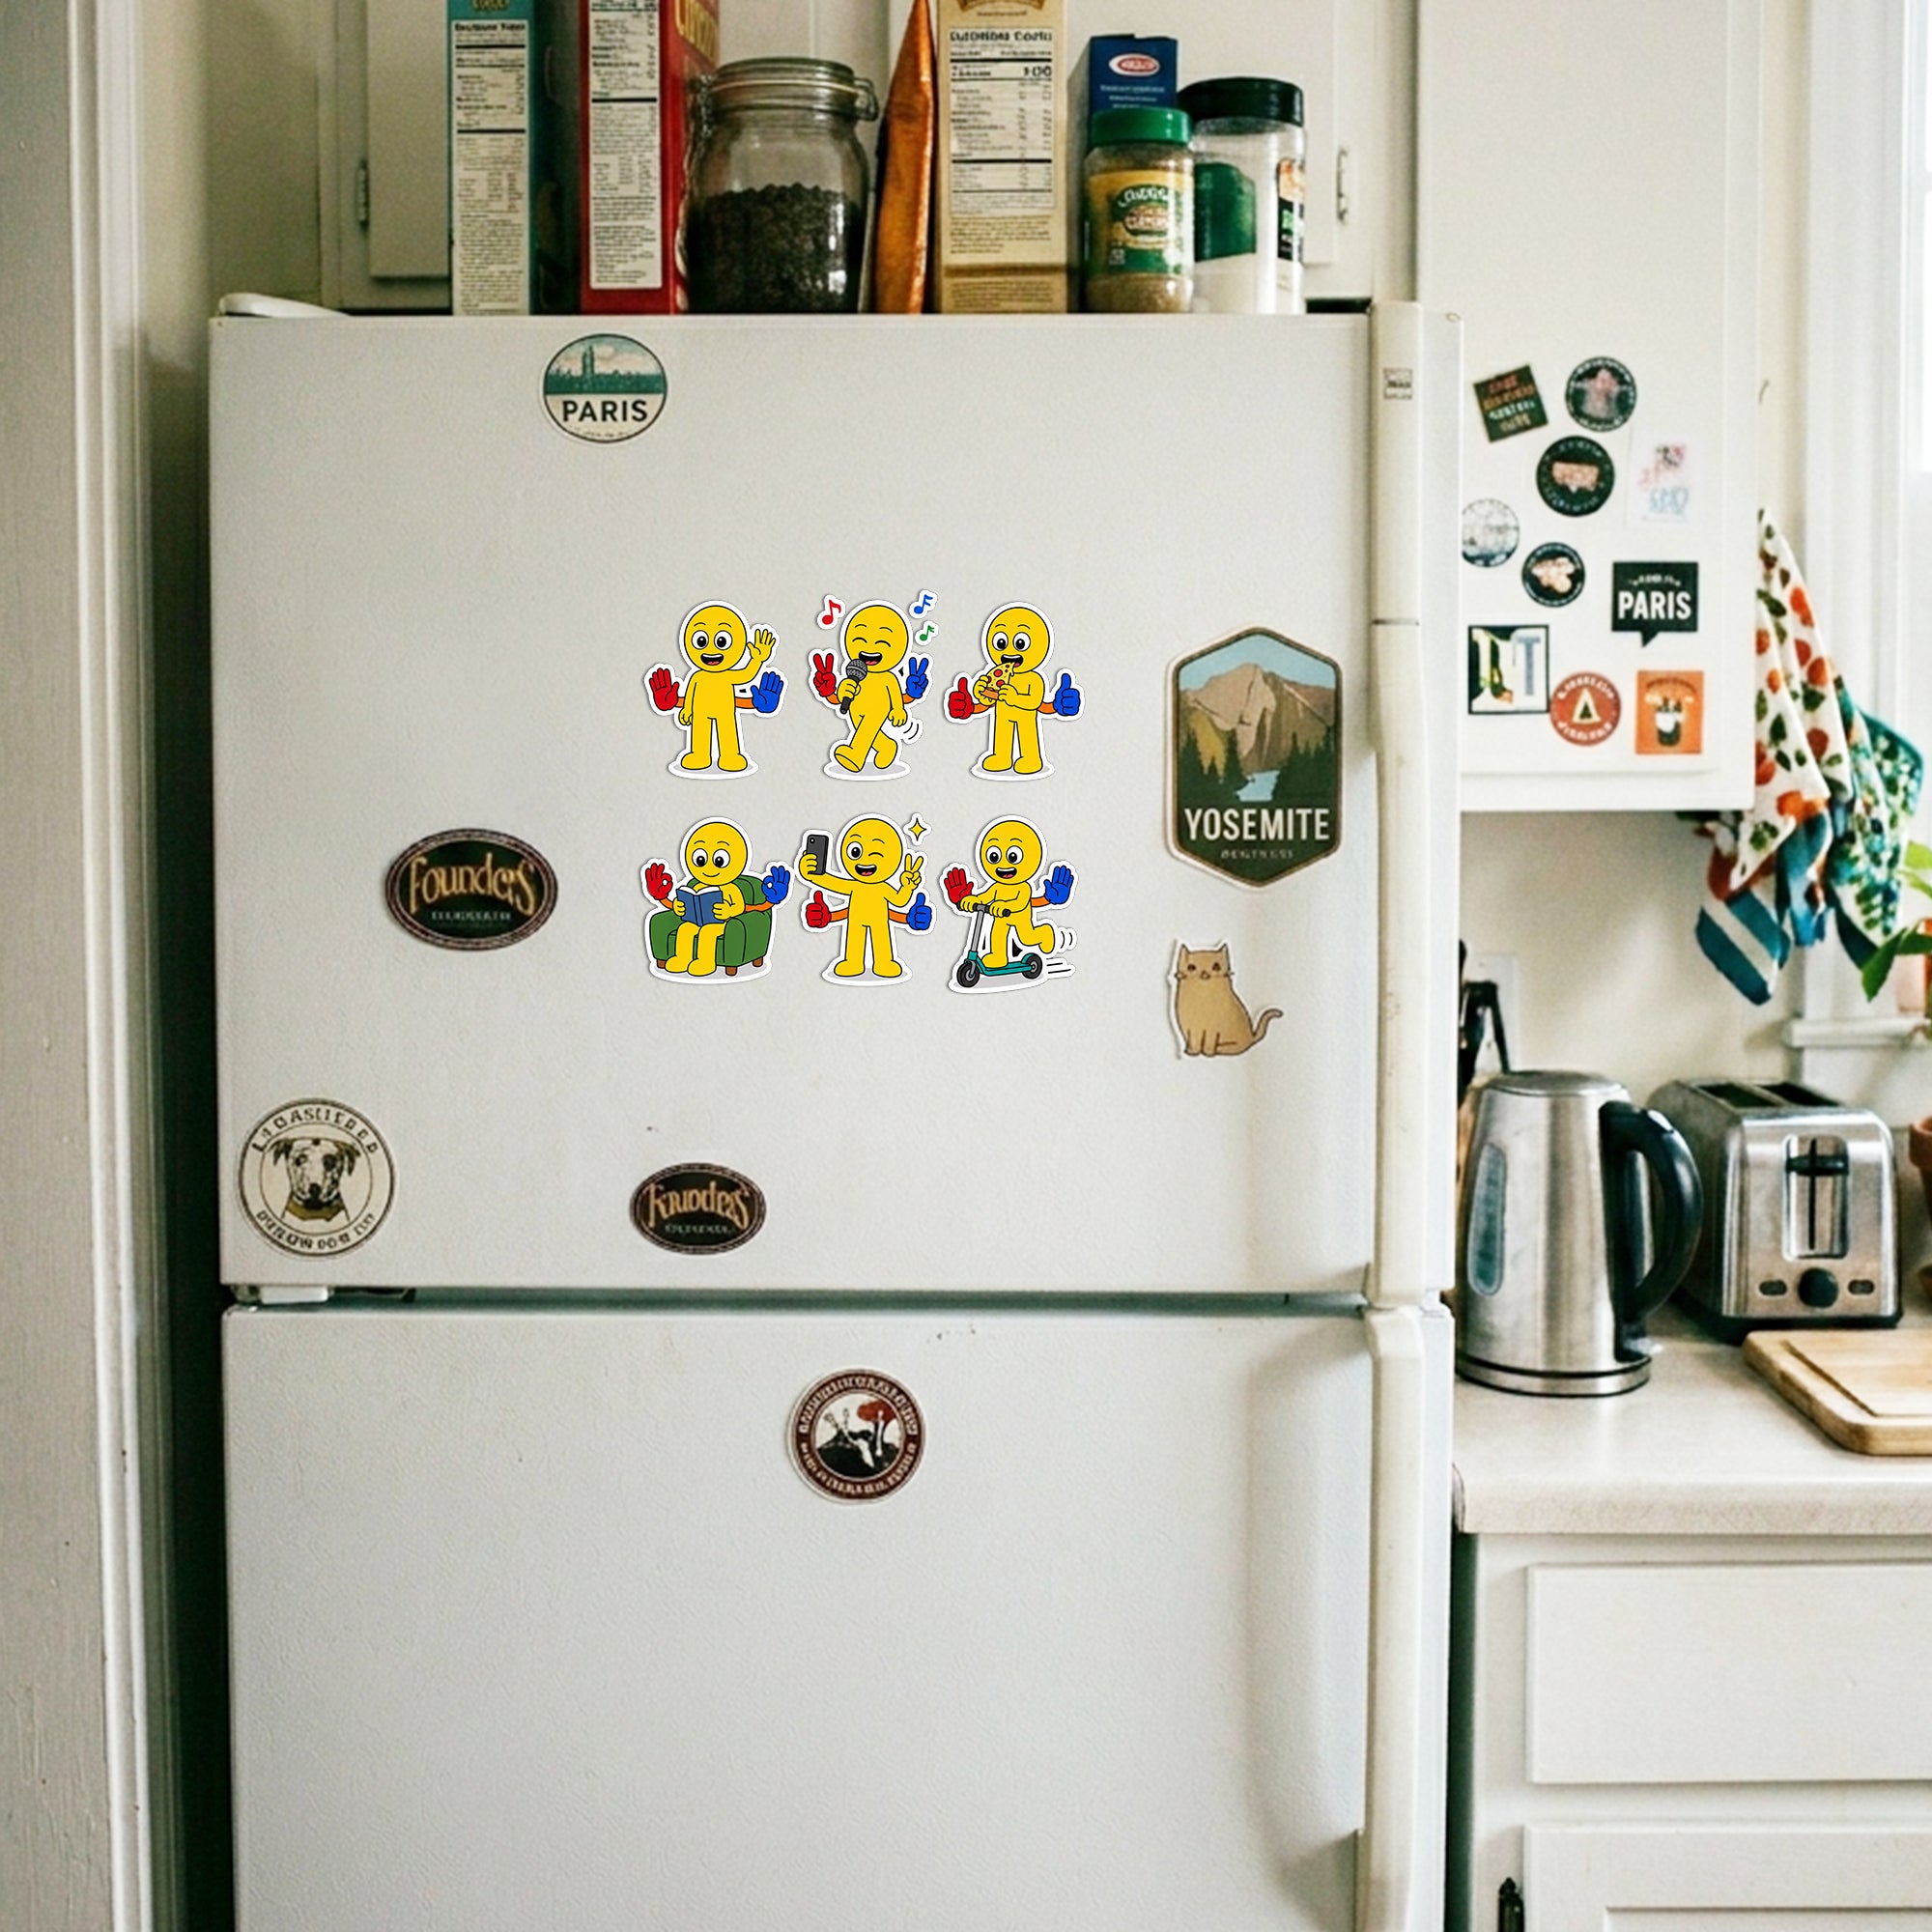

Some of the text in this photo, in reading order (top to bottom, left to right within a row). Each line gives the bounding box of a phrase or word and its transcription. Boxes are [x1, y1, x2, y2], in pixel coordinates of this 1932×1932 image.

[562, 400, 648, 422] PARIS
[1618, 590, 1691, 620] PARIS
[1184, 808, 1330, 840] YOSEMITE
